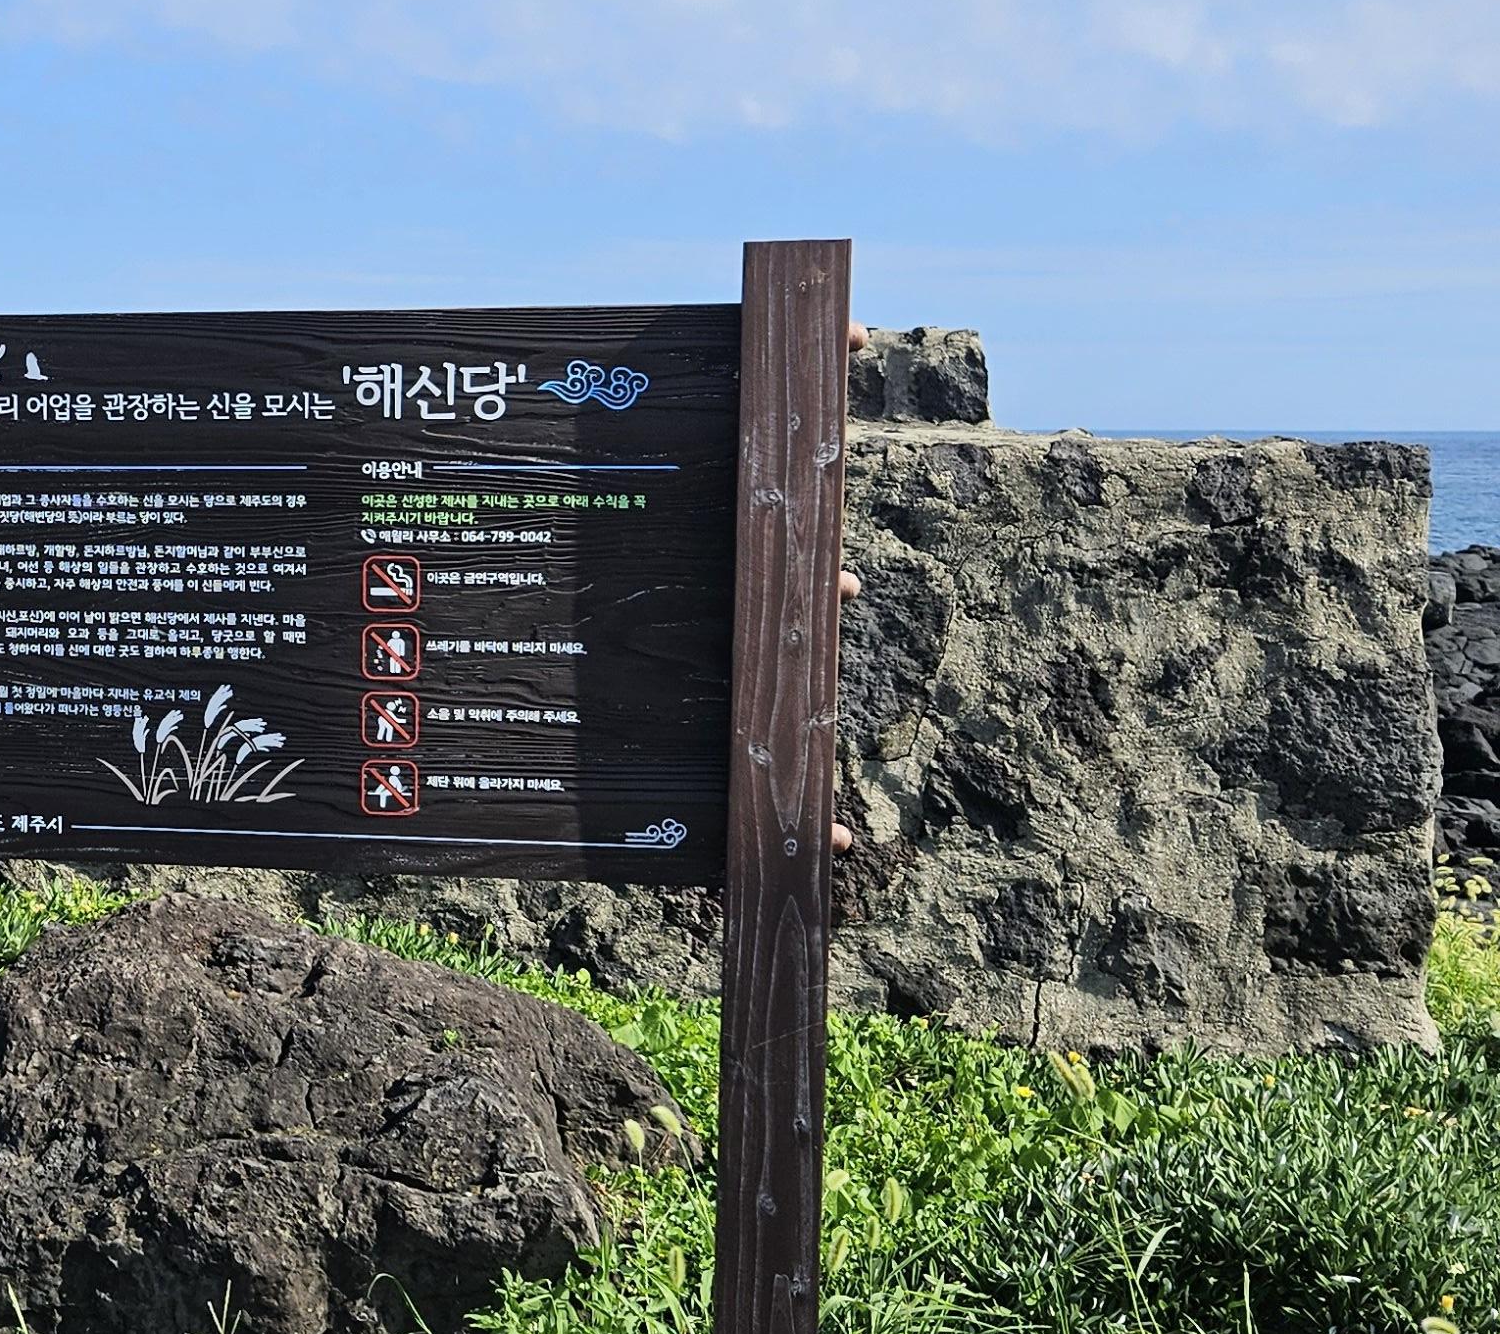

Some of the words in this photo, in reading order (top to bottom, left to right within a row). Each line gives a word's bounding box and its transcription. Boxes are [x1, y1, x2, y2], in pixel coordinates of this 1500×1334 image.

[27, 394, 96, 420] 어업을
[102, 394, 200, 420] 관장하는
[207, 393, 256, 419] 신을
[262, 392, 335, 419] 모시는
[343, 362, 527, 419] '해신당'
[362, 461, 424, 479] 이용안내
[25, 495, 36, 504] 그
[96, 494, 139, 507] 수호하는
[143, 494, 164, 507] 신을
[167, 495, 199, 507] 모시는
[204, 495, 236, 507] 당으로
[240, 495, 282, 506] 제주도의
[286, 495, 306, 508] 경우
[362, 495, 397, 507] 이곳은
[402, 495, 438, 508] 신성한
[441, 495, 478, 508] 제사를
[482, 495, 519, 508] 지내는
[523, 495, 559, 508] 곳으로
[563, 495, 588, 508] 아래
[593, 495, 629, 508] 수칙을
[634, 495, 646, 508] 꼭
[139, 512, 160, 524] 당이
[163, 512, 187, 524] 있다.
[362, 512, 421, 524] 지켜주시기
[424, 512, 478, 525] 바랍니다.
[379, 530, 413, 543] 애월리
[417, 531, 451, 543] 사무소
[462, 531, 551, 542] 064-799-0042
[224, 546, 245, 558] 같이
[250, 546, 306, 558] 부부신으로
[18, 561, 38, 573] 어선
[43, 561, 54, 574] 등
[59, 561, 92, 574] 해상의
[135, 562, 180, 574] 관장하고
[186, 563, 230, 575] 수호하는
[235, 563, 268, 575] 것으로
[273, 564, 306, 575] 여겨서
[4, 578, 50, 590] 중시하고,
[54, 579, 75, 589] 자주
[79, 578, 112, 591] 해상의
[116, 579, 149, 591] 안전과
[187, 580, 198, 591] 이
[202, 580, 245, 592] 신들에게
[249, 580, 274, 592] 빈다.
[427, 572, 461, 584] 이곳은
[464, 573, 546, 585] 금연구역입니다.
[59, 611, 80, 622] 이어
[84, 611, 105, 624] 날이
[145, 612, 199, 625] 해신당에서
[204, 613, 236, 625] 제사를
[241, 614, 278, 626] 지낸다.
[283, 614, 306, 627] 마을
[68, 628, 90, 639] 오과
[97, 628, 118, 641] 등을
[126, 628, 158, 641] 그대로
[167, 629, 203, 642] 올리고,
[212, 630, 256, 642] 당굿으로
[264, 630, 275, 643] 할
[283, 632, 306, 644] 때면
[9, 643, 40, 655] 청하여
[44, 644, 65, 656] 이들
[69, 645, 89, 656] 신에
[93, 645, 116, 657] 대한
[119, 645, 140, 657] 굿도
[144, 646, 176, 657] 겸하여
[227, 647, 265, 659] 행한다.
[474, 641, 508, 653] 바닥에
[512, 642, 546, 653] 버리지
[550, 642, 587, 654] 마세요.
[12, 686, 22, 698] 첫
[25, 686, 56, 699] 정일에
[60, 687, 104, 699] 마을마다
[108, 688, 139, 700] 지내는
[143, 689, 174, 701] 유교식
[179, 690, 200, 701] 제의
[58, 704, 99, 716] 떠나가는
[102, 705, 141, 718] 영등신을
[454, 708, 465, 720] 및
[469, 709, 502, 721] 악취에
[506, 710, 540, 722] 주의해
[543, 711, 580, 723] 주세요.
[426, 776, 450, 787] 제단
[453, 777, 475, 788] 위에
[478, 777, 524, 789] 올라가지
[527, 779, 564, 791] 마세요.
[12, 815, 62, 833] 제주시
